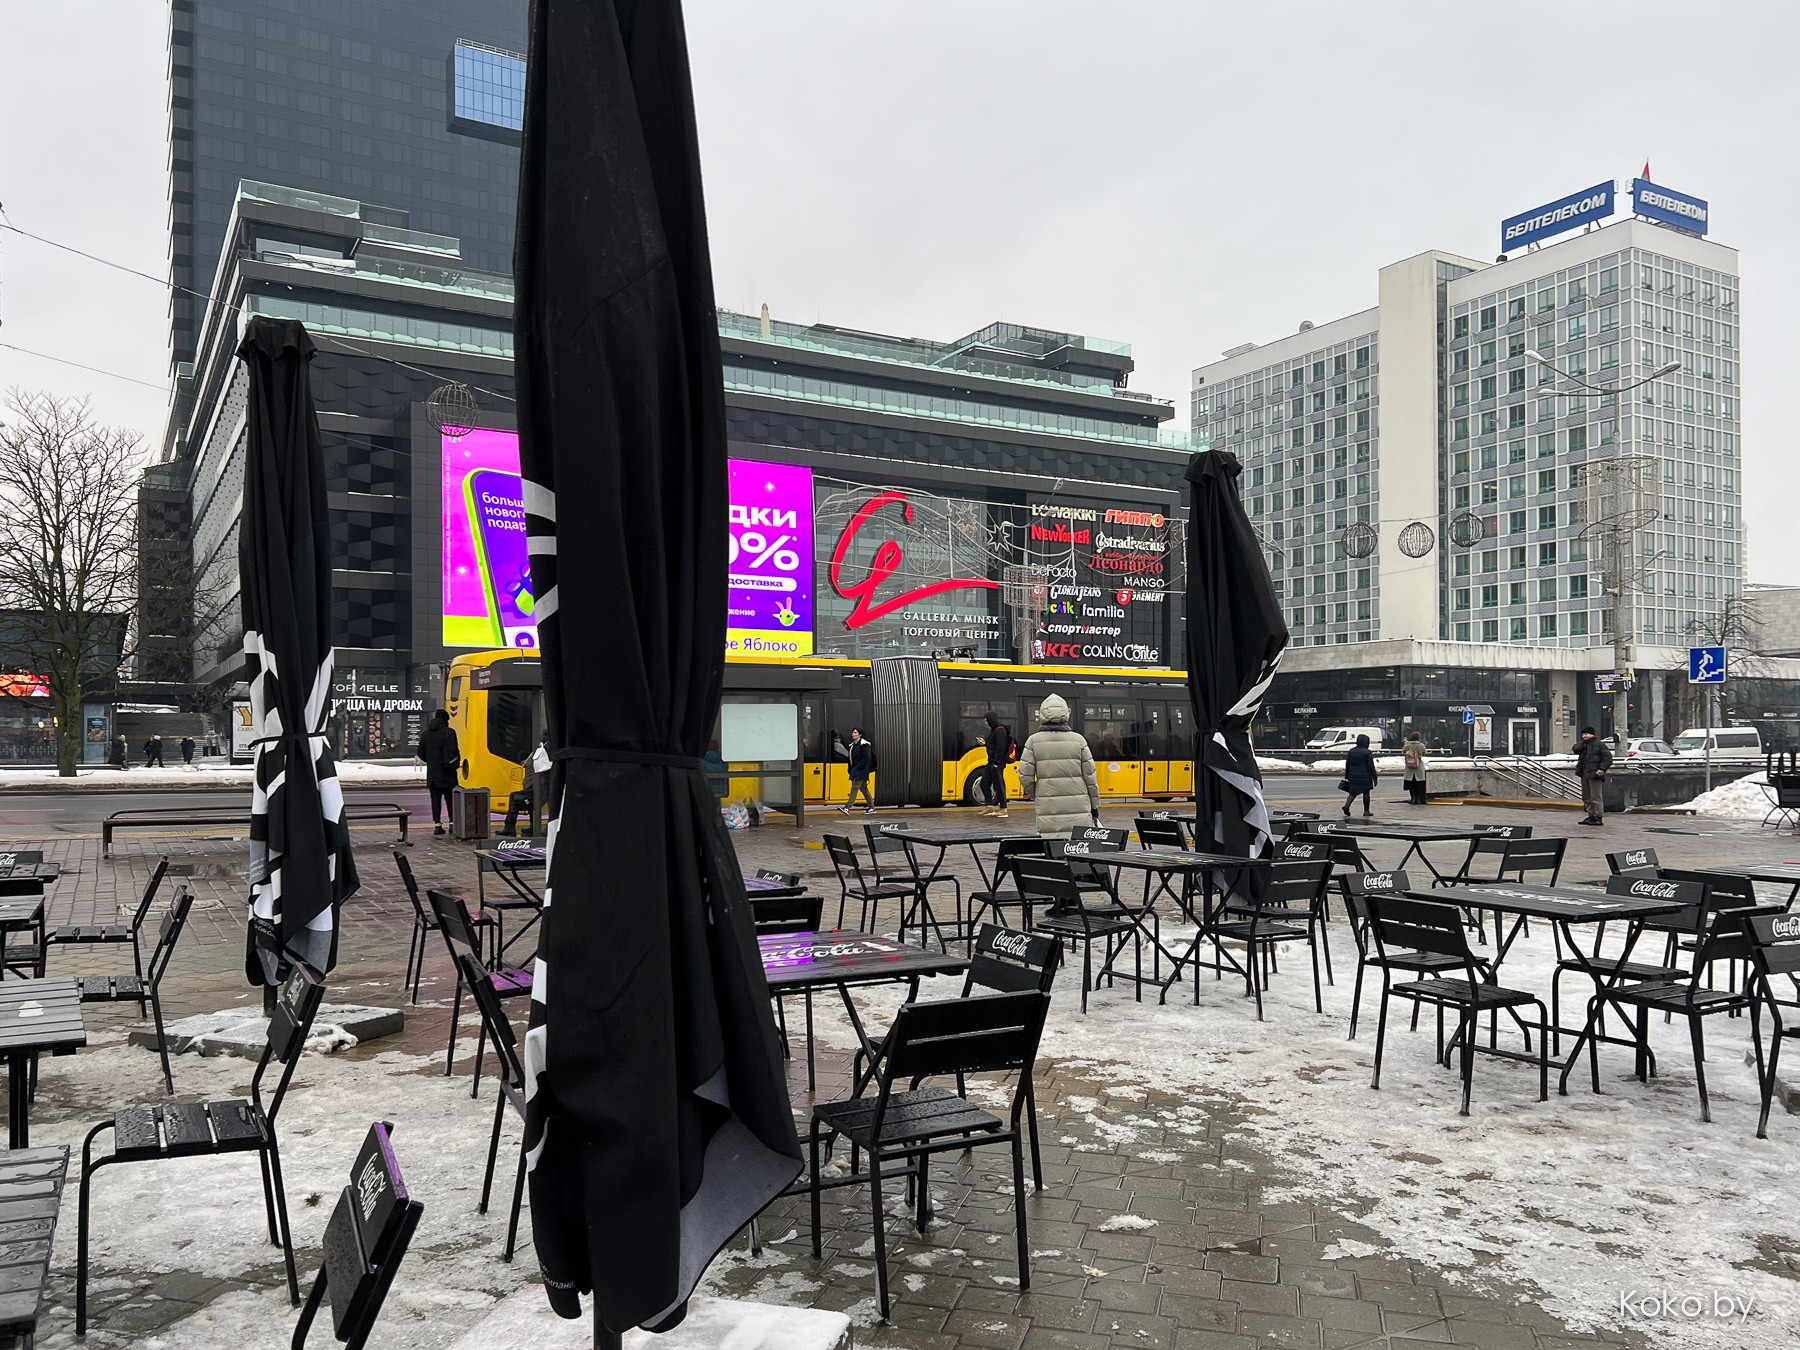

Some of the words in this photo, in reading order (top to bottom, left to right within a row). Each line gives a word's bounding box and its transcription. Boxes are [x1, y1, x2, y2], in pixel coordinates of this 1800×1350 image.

[1639, 190, 1707, 222] БЕЛТЕЛЕКОМ
[1505, 192, 1607, 240] БЕЛТЕЛЕКОМ
[482, 491, 524, 508] больш
[485, 506, 525, 518] новог
[728, 504, 797, 528] дки
[1105, 509, 1165, 527] ГИППО
[487, 519, 526, 532] подар
[1088, 553, 1164, 575] Леонардо
[1124, 577, 1165, 588] MANGO
[1131, 591, 1165, 602] ЭЛЕМЕНТ
[728, 608, 756, 616] жение
[1083, 603, 1125, 618] familia
[903, 611, 959, 624] GALLERIA
[964, 614, 999, 625] MINSK
[903, 626, 960, 638] ТОРГОВЫЙ
[966, 630, 1000, 640] ЦЕНТР
[1048, 624, 1121, 637] спортмастер
[743, 638, 798, 652] Яблоко
[1046, 643, 1082, 658] KFC
[1083, 642, 1123, 658] COLIN'S
[1123, 644, 1158, 662] Conte
[367, 699, 381, 710] НА
[383, 700, 423, 711] ДРОВАХ
